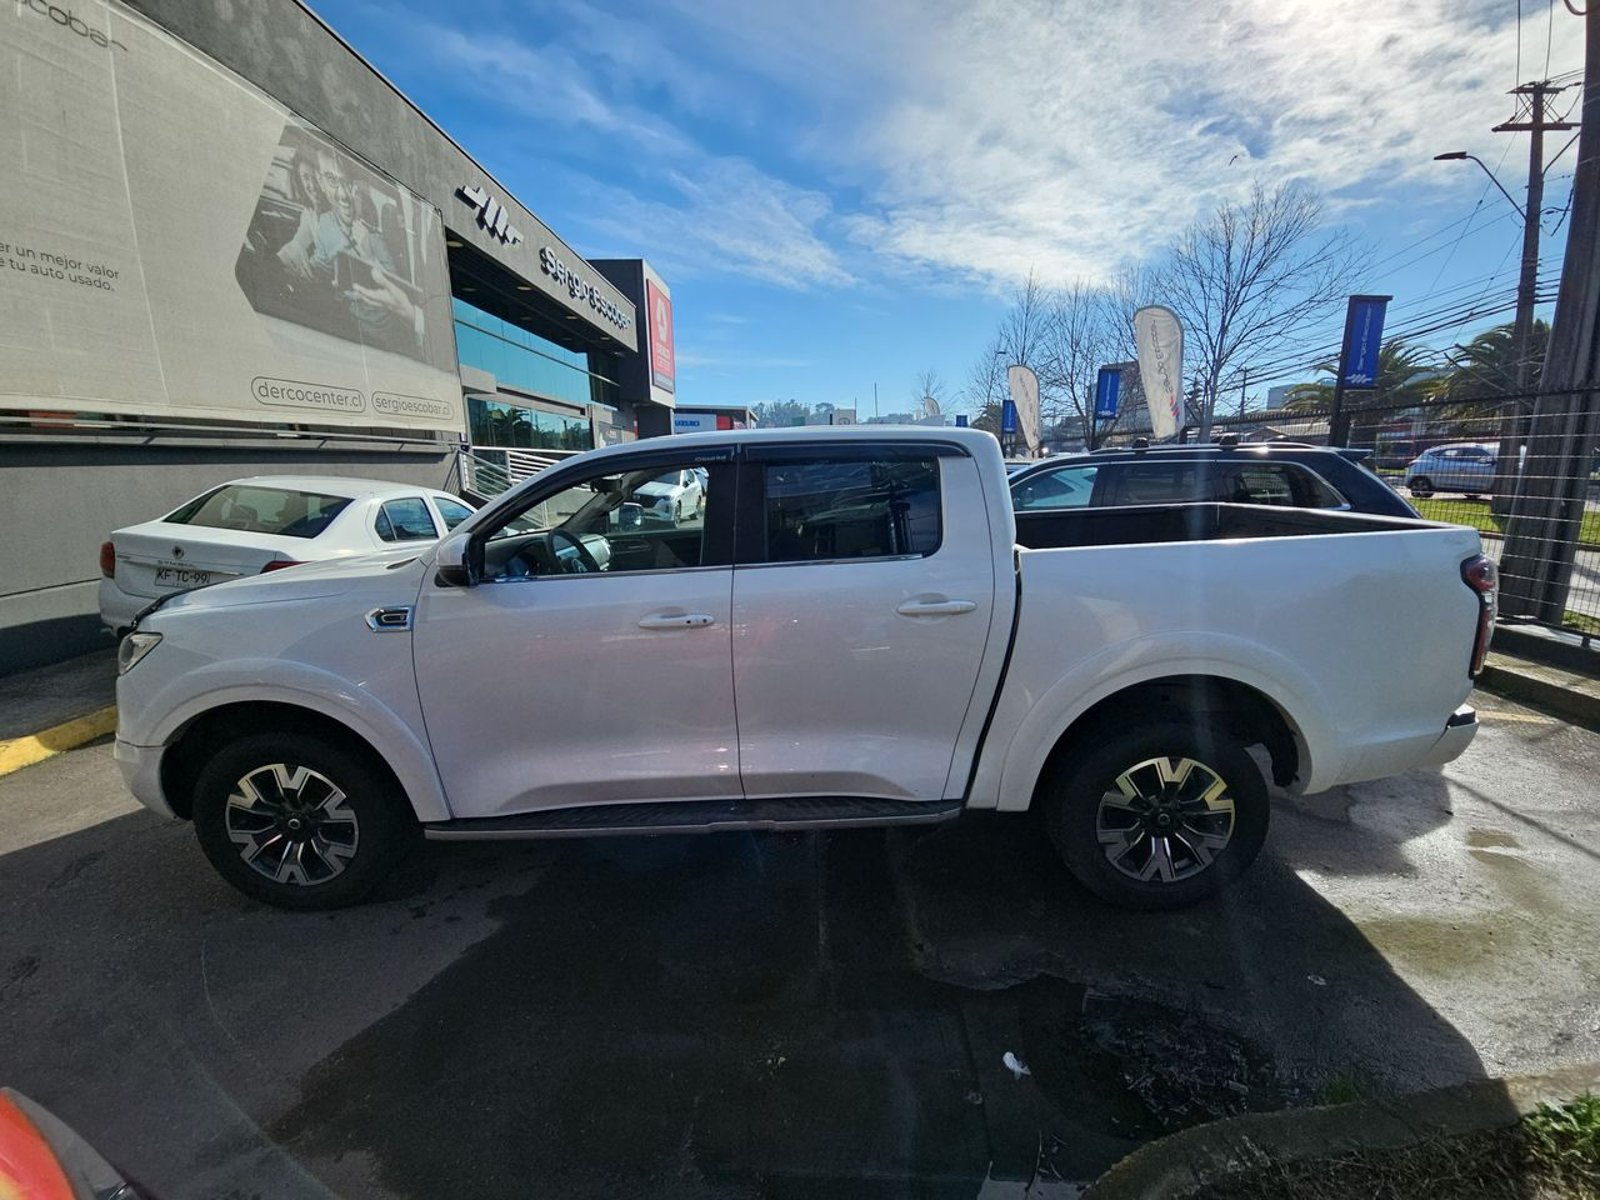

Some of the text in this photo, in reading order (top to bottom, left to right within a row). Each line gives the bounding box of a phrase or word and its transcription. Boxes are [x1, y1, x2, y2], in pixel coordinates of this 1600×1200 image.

[9, 258, 26, 271] tu
[30, 264, 64, 280] auto
[68, 273, 115, 292] usado.
[15, 246, 36, 259] un
[40, 252, 82, 270] mejor
[86, 263, 119, 280] valor
[258, 381, 363, 408] dercocenter.cl
[375, 396, 450, 416] sergioescobar.cl
